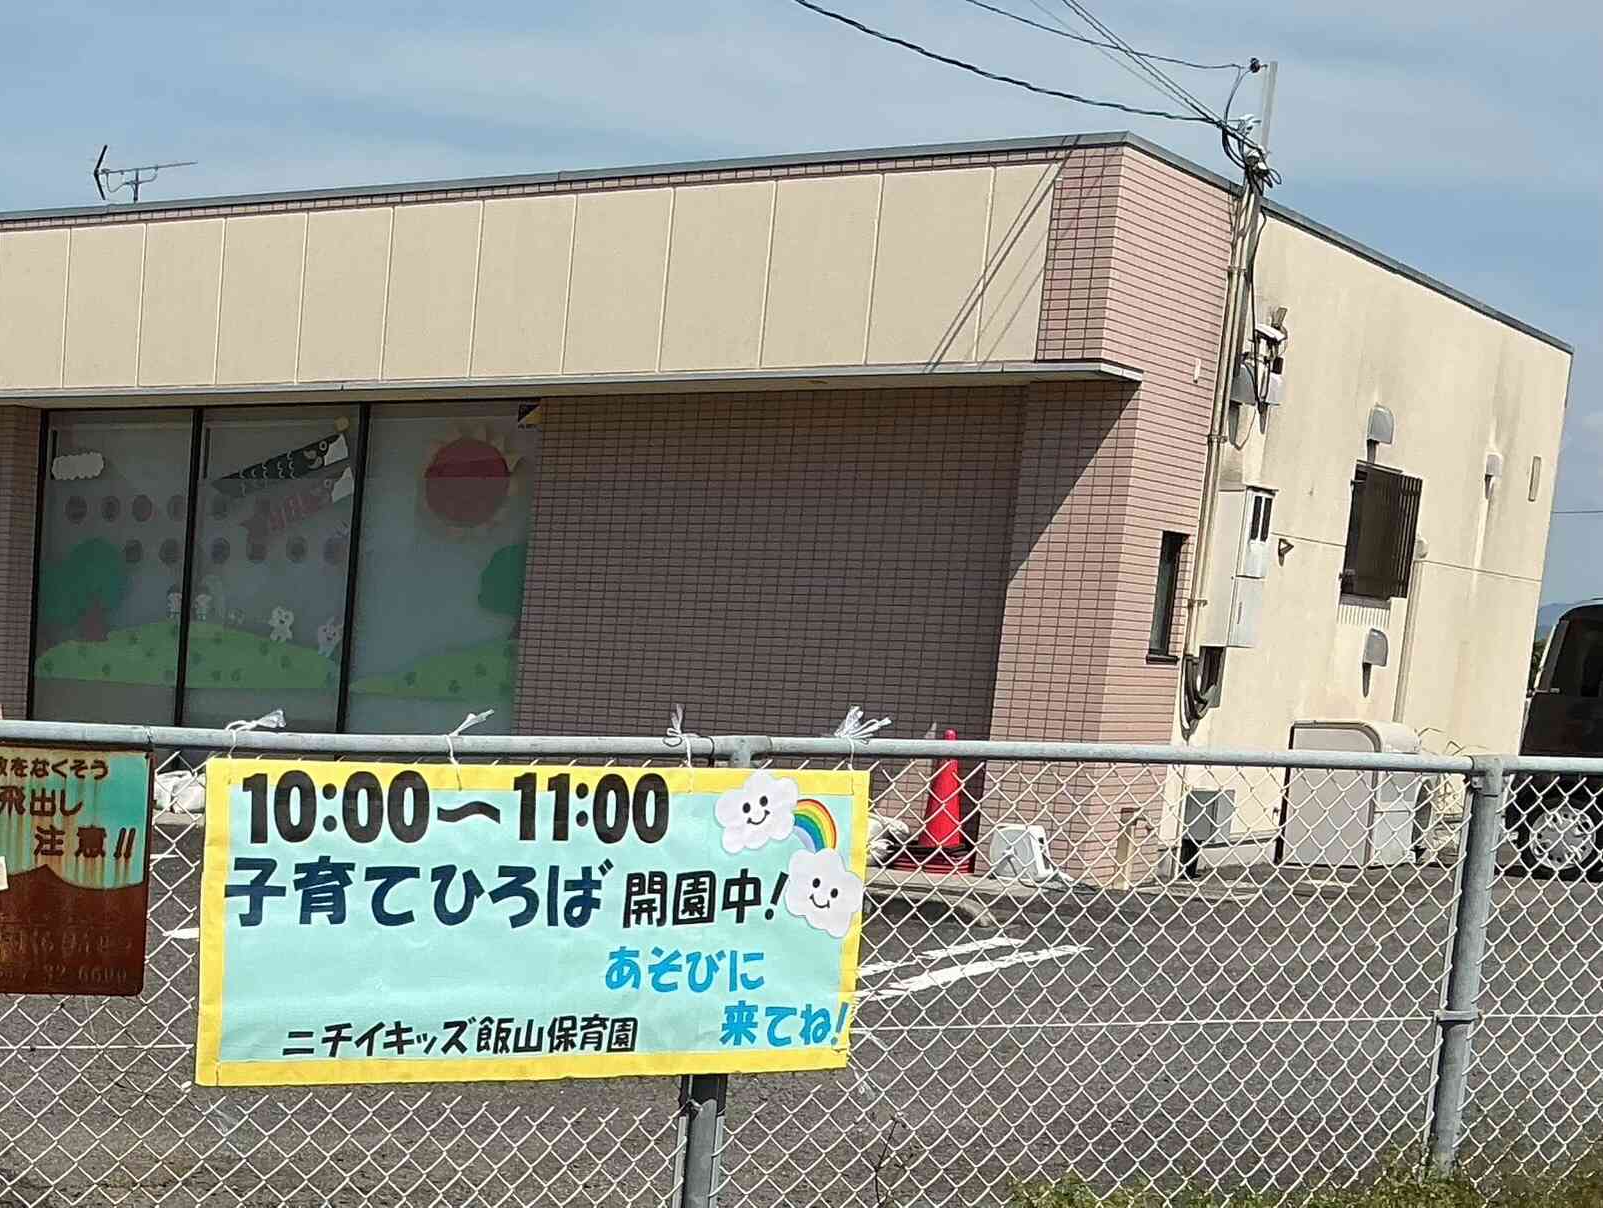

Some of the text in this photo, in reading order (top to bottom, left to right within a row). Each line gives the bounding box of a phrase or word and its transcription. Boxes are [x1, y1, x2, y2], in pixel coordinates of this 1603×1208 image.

[224, 855, 790, 930] 子育てひろば 開園中!
[604, 946, 766, 993] あそびに
[281, 1015, 639, 1058] ニチイキッズ飯山保育園
[720, 1000, 854, 1048] 来てね!
